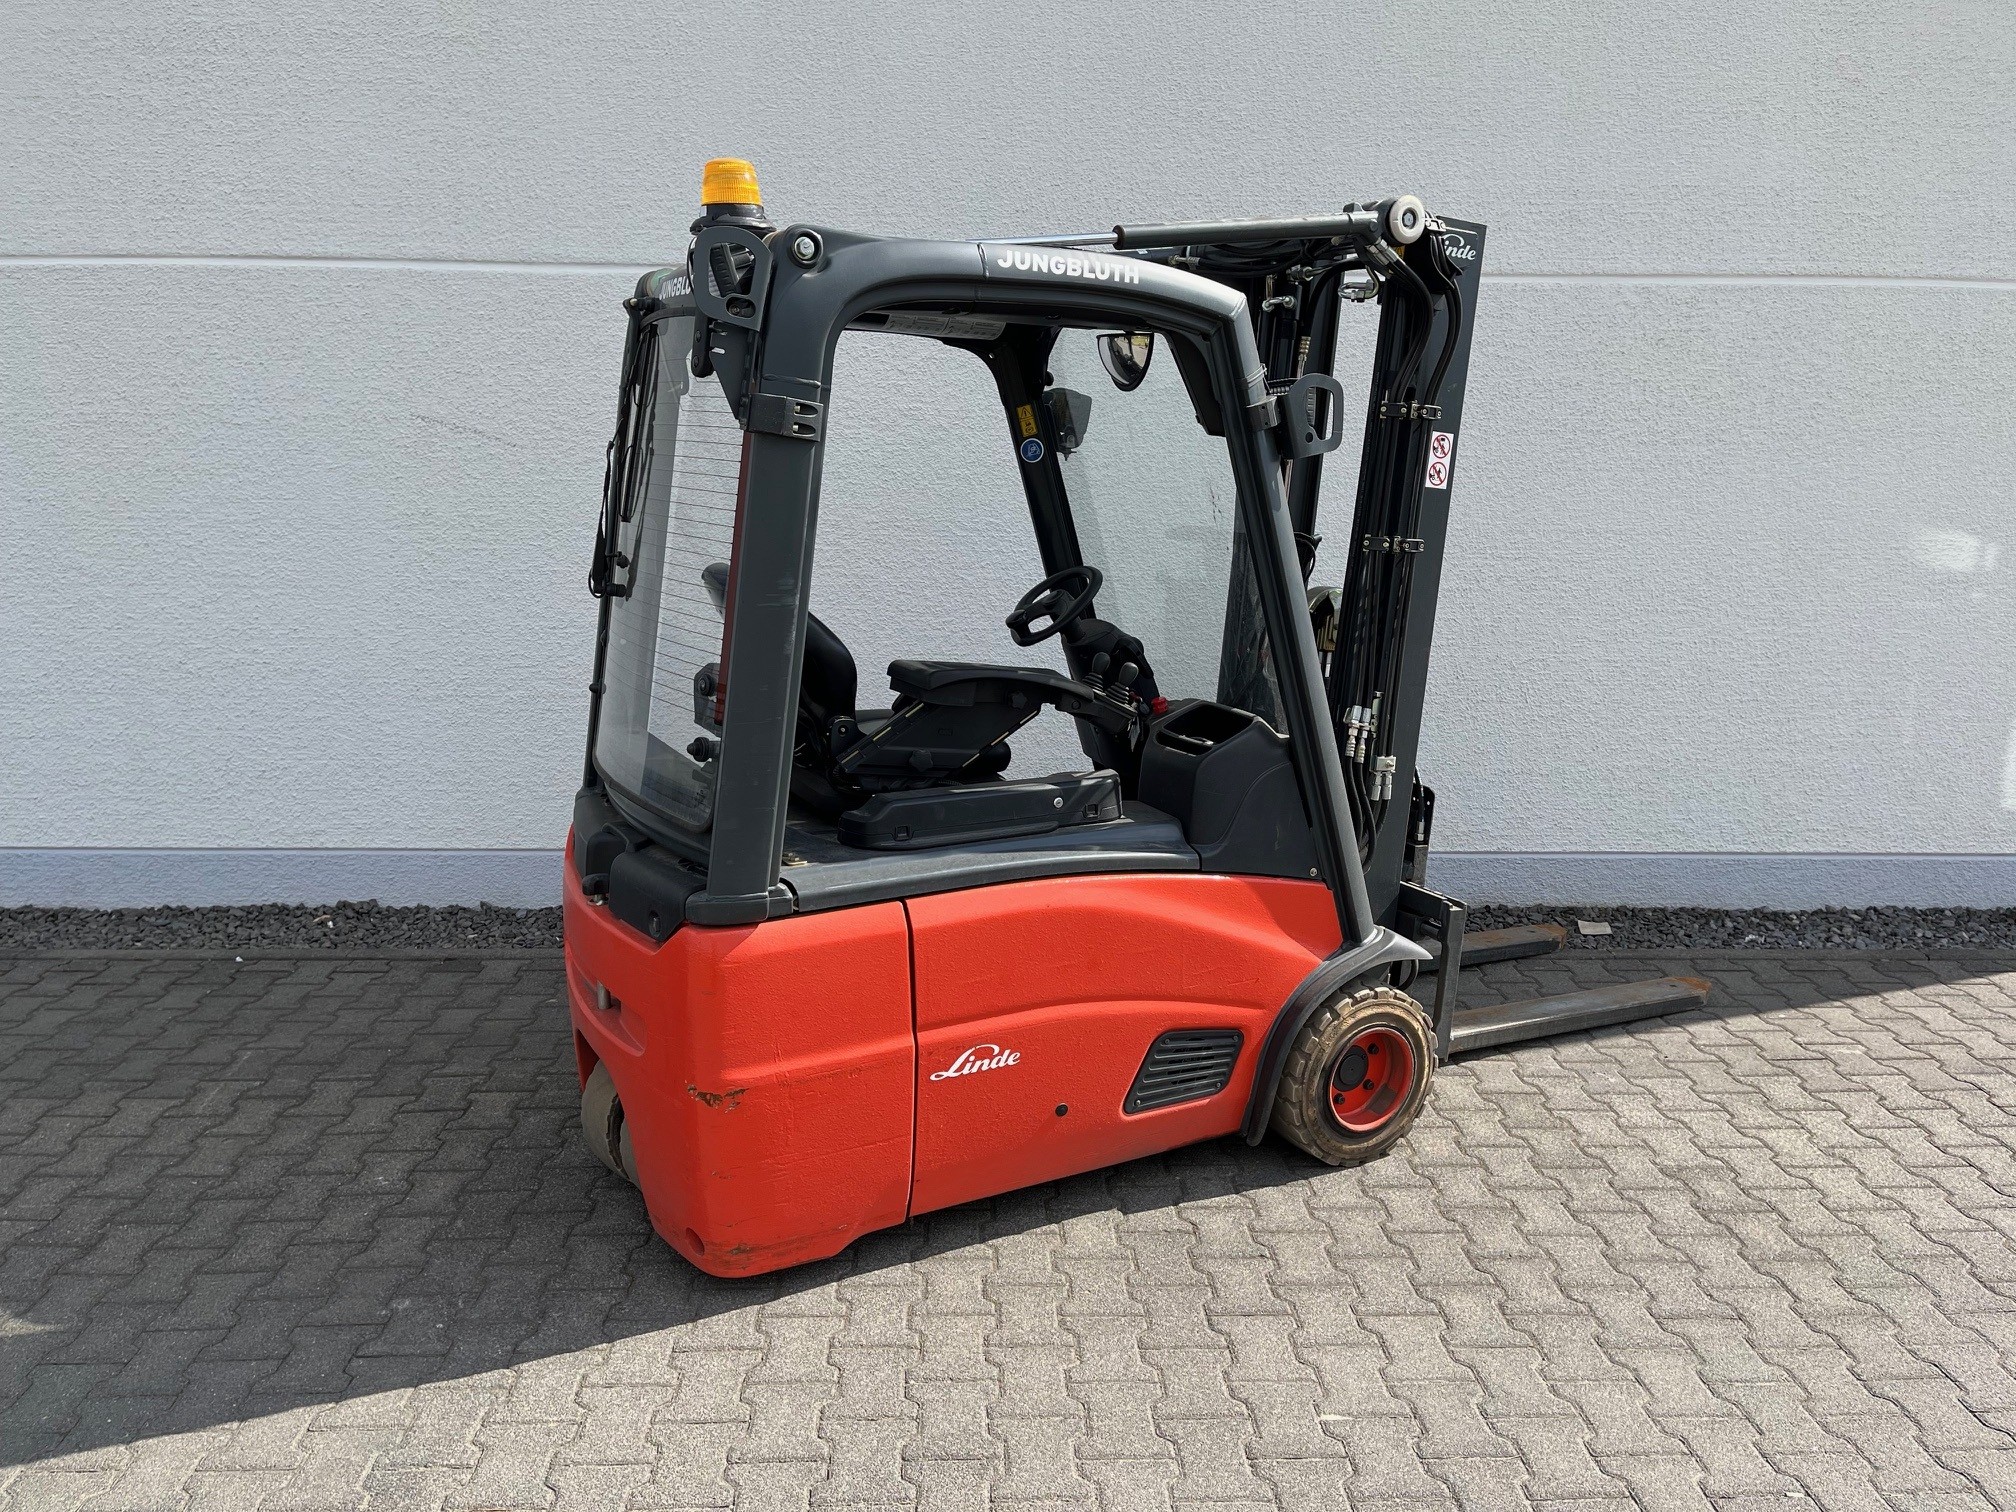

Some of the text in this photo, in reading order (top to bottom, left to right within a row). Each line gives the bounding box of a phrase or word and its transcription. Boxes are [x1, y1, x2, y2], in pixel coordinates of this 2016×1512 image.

[1443, 233, 1476, 260] inde
[997, 250, 1140, 284] JUNGBLUTH
[929, 1043, 1021, 1081] Linde
